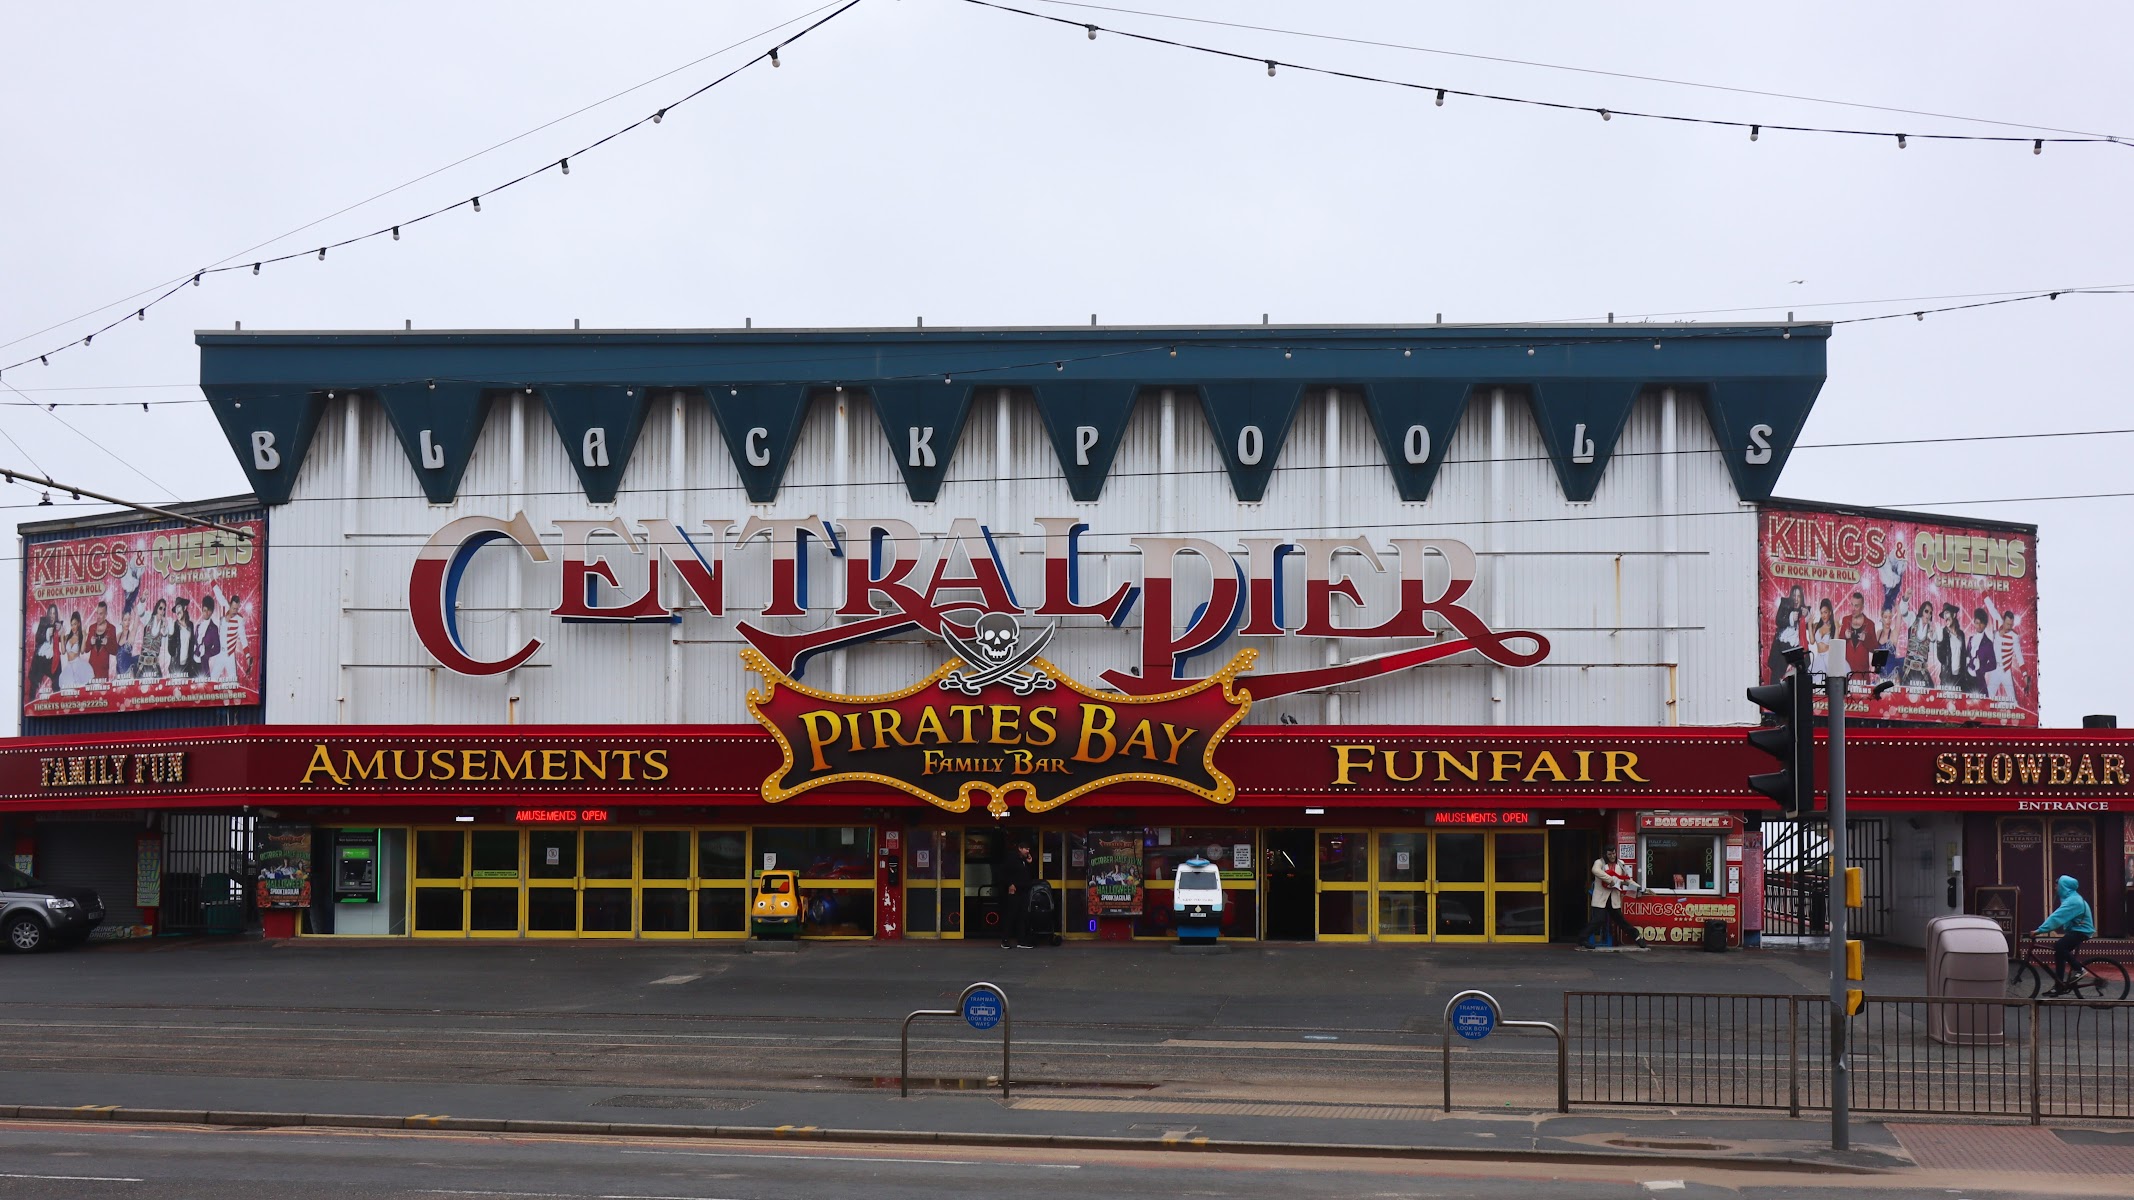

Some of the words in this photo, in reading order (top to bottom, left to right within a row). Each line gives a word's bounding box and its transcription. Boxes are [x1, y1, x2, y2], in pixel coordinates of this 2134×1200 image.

[33, 541, 128, 585] KINGS
[135, 551, 145, 567] &
[152, 526, 254, 580] QUEENS
[1768, 515, 1886, 568] KINGS
[1895, 541, 1906, 560] &
[1914, 531, 2027, 579] QUEENS
[169, 570, 212, 585] CENTRAL
[217, 567, 238, 579] PIER
[1775, 564, 1786, 574] OF
[1811, 567, 1828, 578] POP
[1828, 570, 1835, 579] &
[1836, 570, 1856, 581] ROLL
[37, 588, 46, 598] OF
[65, 586, 79, 596] POP
[80, 585, 85, 594] &
[85, 584, 102, 593] ROLL
[1935, 576, 1980, 591] CENTRAL
[1986, 580, 2010, 592] PIER
[409, 508, 1138, 678] CENTRAL
[1098, 535, 1551, 702] PIER
[798, 703, 1058, 772] PIRATES
[1070, 702, 1200, 766] BAY
[40, 754, 128, 786] FAMILY
[135, 752, 185, 784] FUN
[300, 744, 669, 786] AMUSEMENTS
[921, 749, 1006, 776] FAMILY
[1003, 748, 1075, 775] BAR
[1330, 745, 1650, 785] FUNFAIR
[1936, 752, 2130, 785] SHOWBAR
[2018, 801, 2109, 811] ENTRANCE
[515, 810, 577, 821] AMUSEMENTS
[581, 810, 607, 821] OPEN
[1435, 812, 1497, 823] AMUSEMENTS
[1502, 812, 1528, 823] OPEN
[1654, 817, 1678, 827] BOX
[1680, 817, 1719, 827] OFFICE
[1096, 885, 1137, 895] HALLOWEEN
[1623, 902, 1674, 916] KINGS
[1674, 903, 1686, 917] &
[1685, 903, 1736, 917] QUEENS
